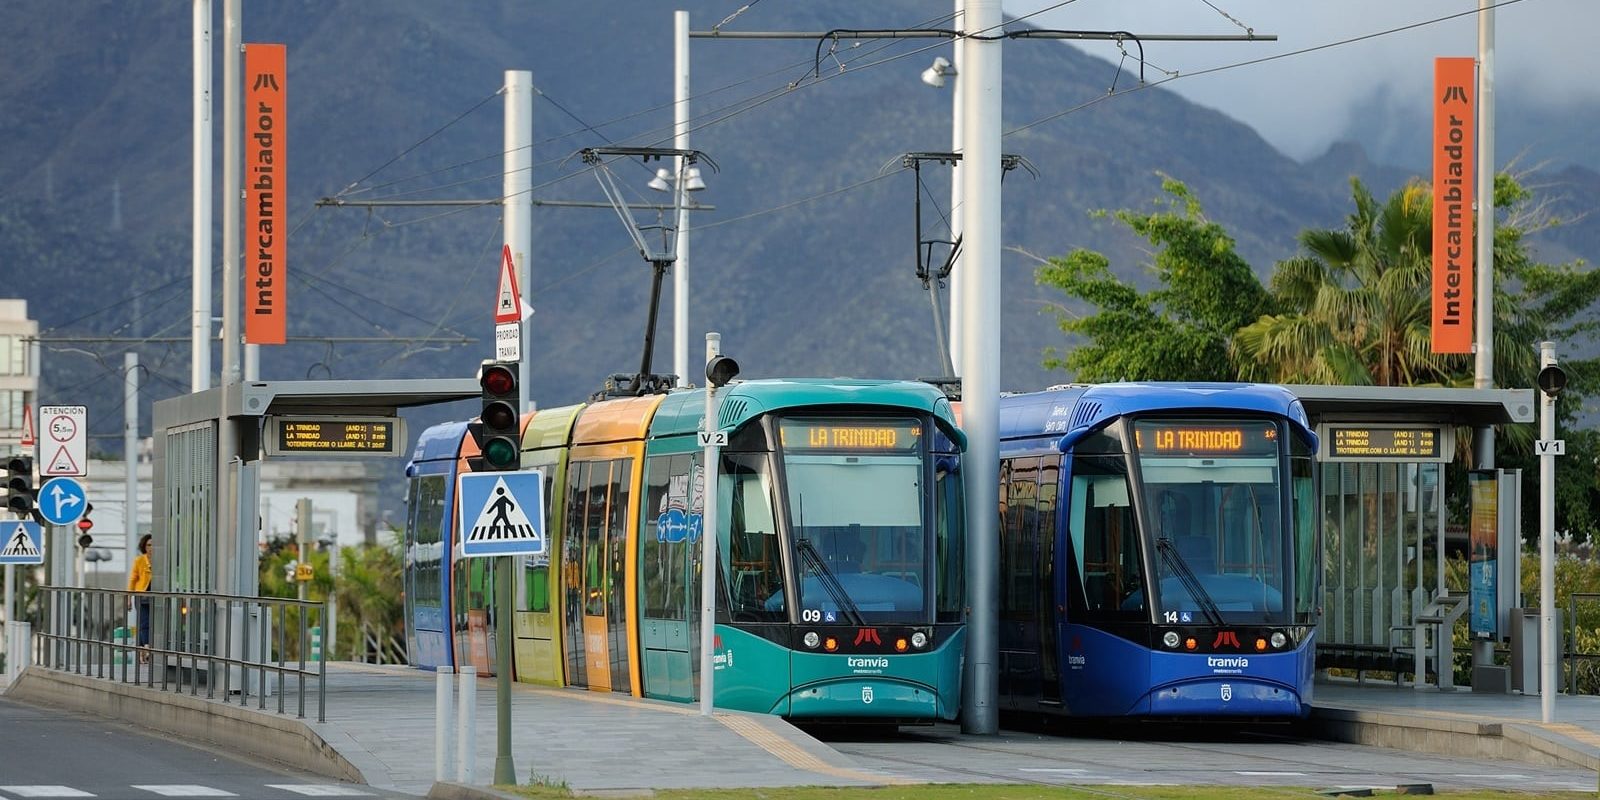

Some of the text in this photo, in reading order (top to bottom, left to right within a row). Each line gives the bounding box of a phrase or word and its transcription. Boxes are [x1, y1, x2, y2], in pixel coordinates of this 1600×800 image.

[254, 101, 273, 315] Intercambiador
[1442, 115, 1463, 325] Intercambiador
[497, 329, 518, 340] PRIORIDAD
[286, 424, 294, 432] LA
[296, 424, 321, 432] TRINIDAD
[286, 432, 294, 440] LA
[296, 432, 321, 440] TRINIDAD
[701, 433, 724, 444] V 2
[810, 428, 828, 447] LA
[832, 428, 897, 447] TRINIDAD
[1156, 430, 1174, 449] LA
[1178, 430, 1242, 449] TRINIDAD
[358, 441, 366, 449] AL
[1410, 447, 1417, 455] AL
[1538, 442, 1560, 452] V 1
[802, 609, 821, 622] 09
[1163, 611, 1178, 623] 14
[847, 656, 888, 668] tranvía
[1207, 656, 1249, 668] tranvía
